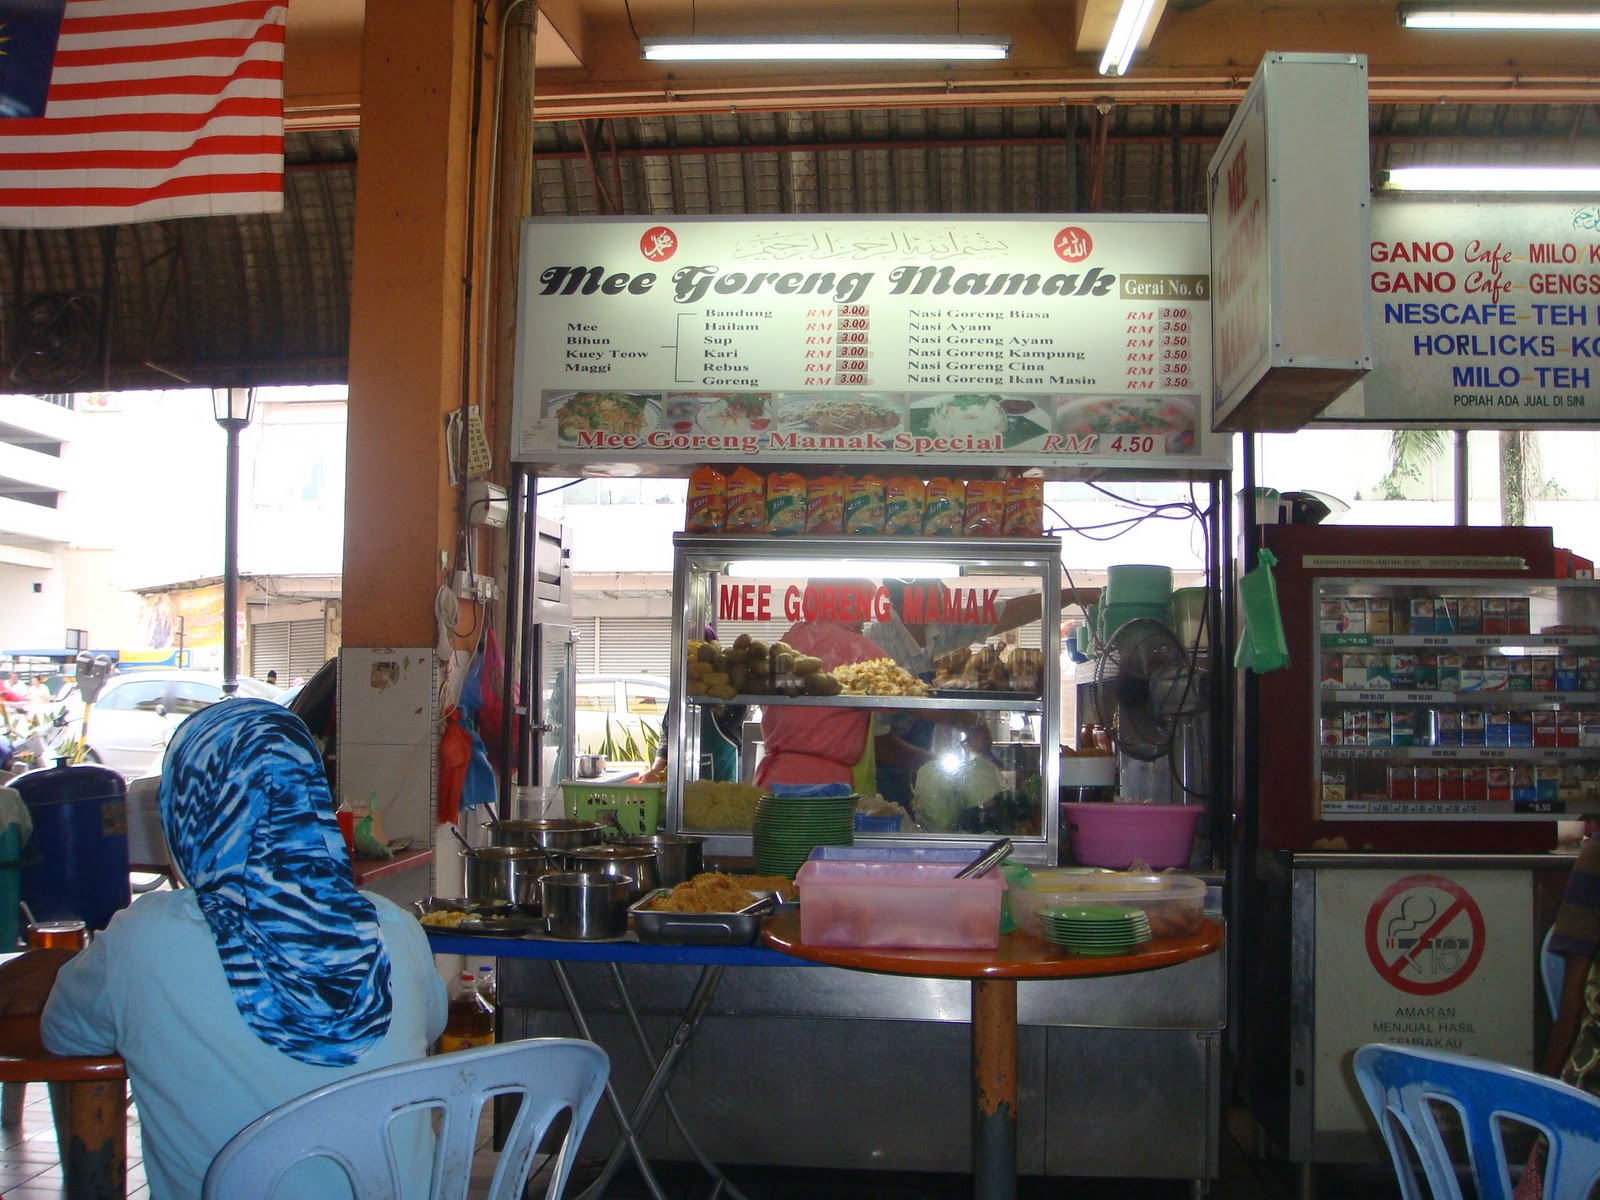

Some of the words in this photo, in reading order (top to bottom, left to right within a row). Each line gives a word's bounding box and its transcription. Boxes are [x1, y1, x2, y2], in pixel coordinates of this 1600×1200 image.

[1370, 241, 1454, 263] GANO
[1464, 239, 1512, 275] Cafe
[539, 265, 657, 296] Mee
[671, 265, 875, 304] Goreng
[888, 265, 1117, 297] Mamak
[1124, 279, 1164, 296] Gerai
[1168, 279, 1193, 296] No.
[1195, 280, 1204, 296] 6
[1371, 271, 1457, 293] GANO
[1464, 271, 1512, 304] Cafe
[705, 309, 773, 319] Bandung
[806, 309, 833, 318] RM
[842, 305, 865, 315] 3.00
[908, 309, 941, 319] Nasi
[947, 310, 1004, 320] Goreng
[1009, 310, 1050, 319] Biasa
[1126, 311, 1154, 320] RM
[1163, 309, 1187, 319] 3.00
[1384, 303, 1517, 325] NESCAFE
[1531, 304, 1587, 326] TEH
[567, 323, 598, 332] Mee
[704, 322, 759, 331] Hailam
[806, 322, 833, 331] RM
[842, 319, 865, 329] 3.00
[908, 322, 941, 331] Nasi
[947, 323, 991, 333] Ayam
[1126, 325, 1154, 334] RM
[1164, 322, 1188, 332] 3.50
[566, 336, 610, 345] Bihun
[704, 336, 733, 346] Sup
[805, 336, 833, 345] RM
[841, 333, 865, 343] 3.00
[908, 335, 941, 344] Nasi
[946, 336, 1004, 346] Goreng
[1009, 336, 1053, 346] Ayam
[1126, 338, 1154, 348] RM
[1164, 336, 1188, 346] 3.50
[1413, 334, 1555, 356] HORLICKS
[565, 350, 604, 360] Kuey
[609, 350, 649, 359] Teow
[704, 349, 738, 358] Kari
[804, 350, 833, 359] RM
[841, 347, 865, 357] 3.00
[908, 348, 941, 358] Nasi
[946, 349, 1004, 359] Goreng
[1009, 349, 1085, 361] Kampung
[1126, 352, 1154, 362] RM
[1164, 350, 1188, 360] 3.50
[565, 363, 612, 374] Maggi
[703, 362, 750, 372] Rebus
[804, 363, 833, 372] RM
[841, 361, 865, 370] 3.00
[908, 361, 941, 370] Nasi
[946, 362, 1004, 372] Goreng
[1009, 362, 1045, 371] Cina
[1126, 366, 1154, 375] RM
[1164, 364, 1188, 374] 3.50
[702, 376, 759, 387] Goreng
[803, 377, 832, 386] RM
[840, 374, 864, 384] 3.00
[907, 374, 941, 383] Nasi
[946, 375, 1004, 385] Goreng
[1009, 375, 1043, 384] Ikan
[1050, 376, 1096, 385] Masin
[1126, 380, 1154, 389] RM
[1164, 378, 1188, 387] 3.50
[1453, 366, 1521, 388] MILO
[1534, 367, 1590, 389] TEH
[1454, 395, 1493, 407] POPIAH
[1497, 395, 1519, 406] ADA
[1524, 395, 1550, 407] JUAL
[1553, 395, 1563, 407] DI
[1566, 396, 1585, 407] SINI
[577, 431, 637, 449] Mee
[647, 431, 760, 455] Goreng
[767, 432, 885, 449] Mamak
[893, 434, 1005, 456] Special
[1042, 435, 1098, 452] RM
[1110, 436, 1154, 453] 4.50
[719, 584, 772, 621] MEE
[784, 584, 891, 623] GORENG
[903, 587, 999, 625] MAMAK
[1395, 1007, 1456, 1018] AMARAN
[1373, 1022, 1434, 1033] MENJUAL
[1438, 1022, 1476, 1033] HASIL
